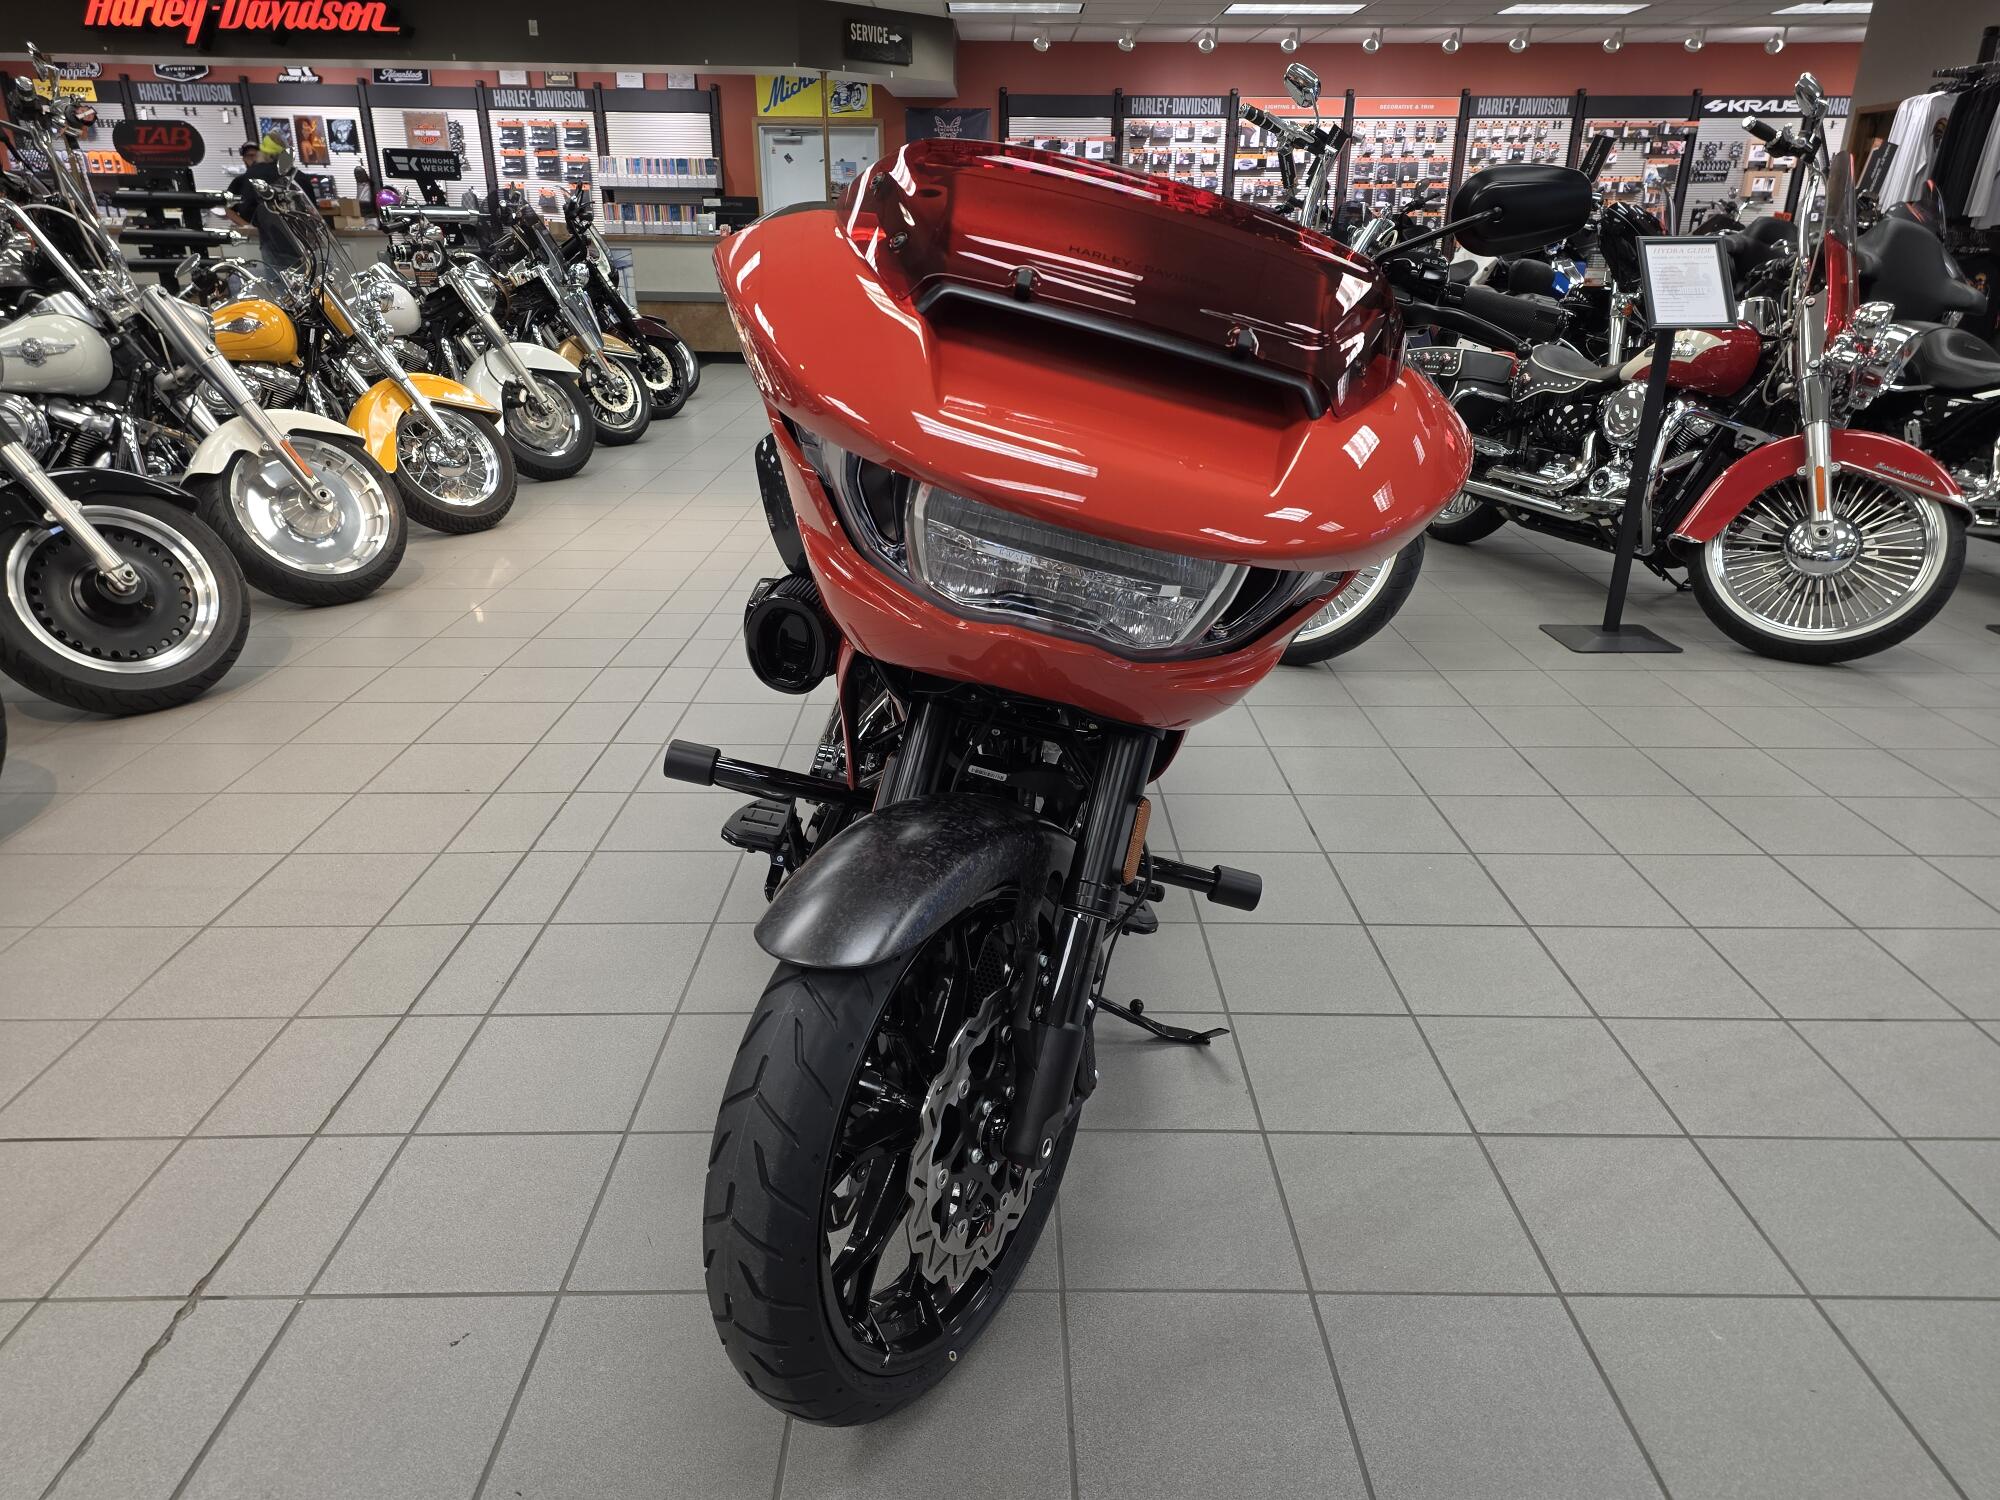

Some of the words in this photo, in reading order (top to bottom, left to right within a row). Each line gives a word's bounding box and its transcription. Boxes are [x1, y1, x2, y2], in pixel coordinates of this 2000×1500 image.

[84, 0, 401, 44] Harley-Davidson
[850, 23, 889, 44] SERVICE
[137, 83, 235, 102] HARLEY-DAVIDSON
[492, 89, 589, 108] HARLEY-DAVIDSON
[1131, 97, 1224, 115] HARLEY-DAVIDSON
[1477, 97, 1570, 115] HARLEY-DAVIDSON
[134, 126, 192, 149] TAB
[420, 157, 455, 165] KHROME
[421, 164, 456, 173] WERKS
